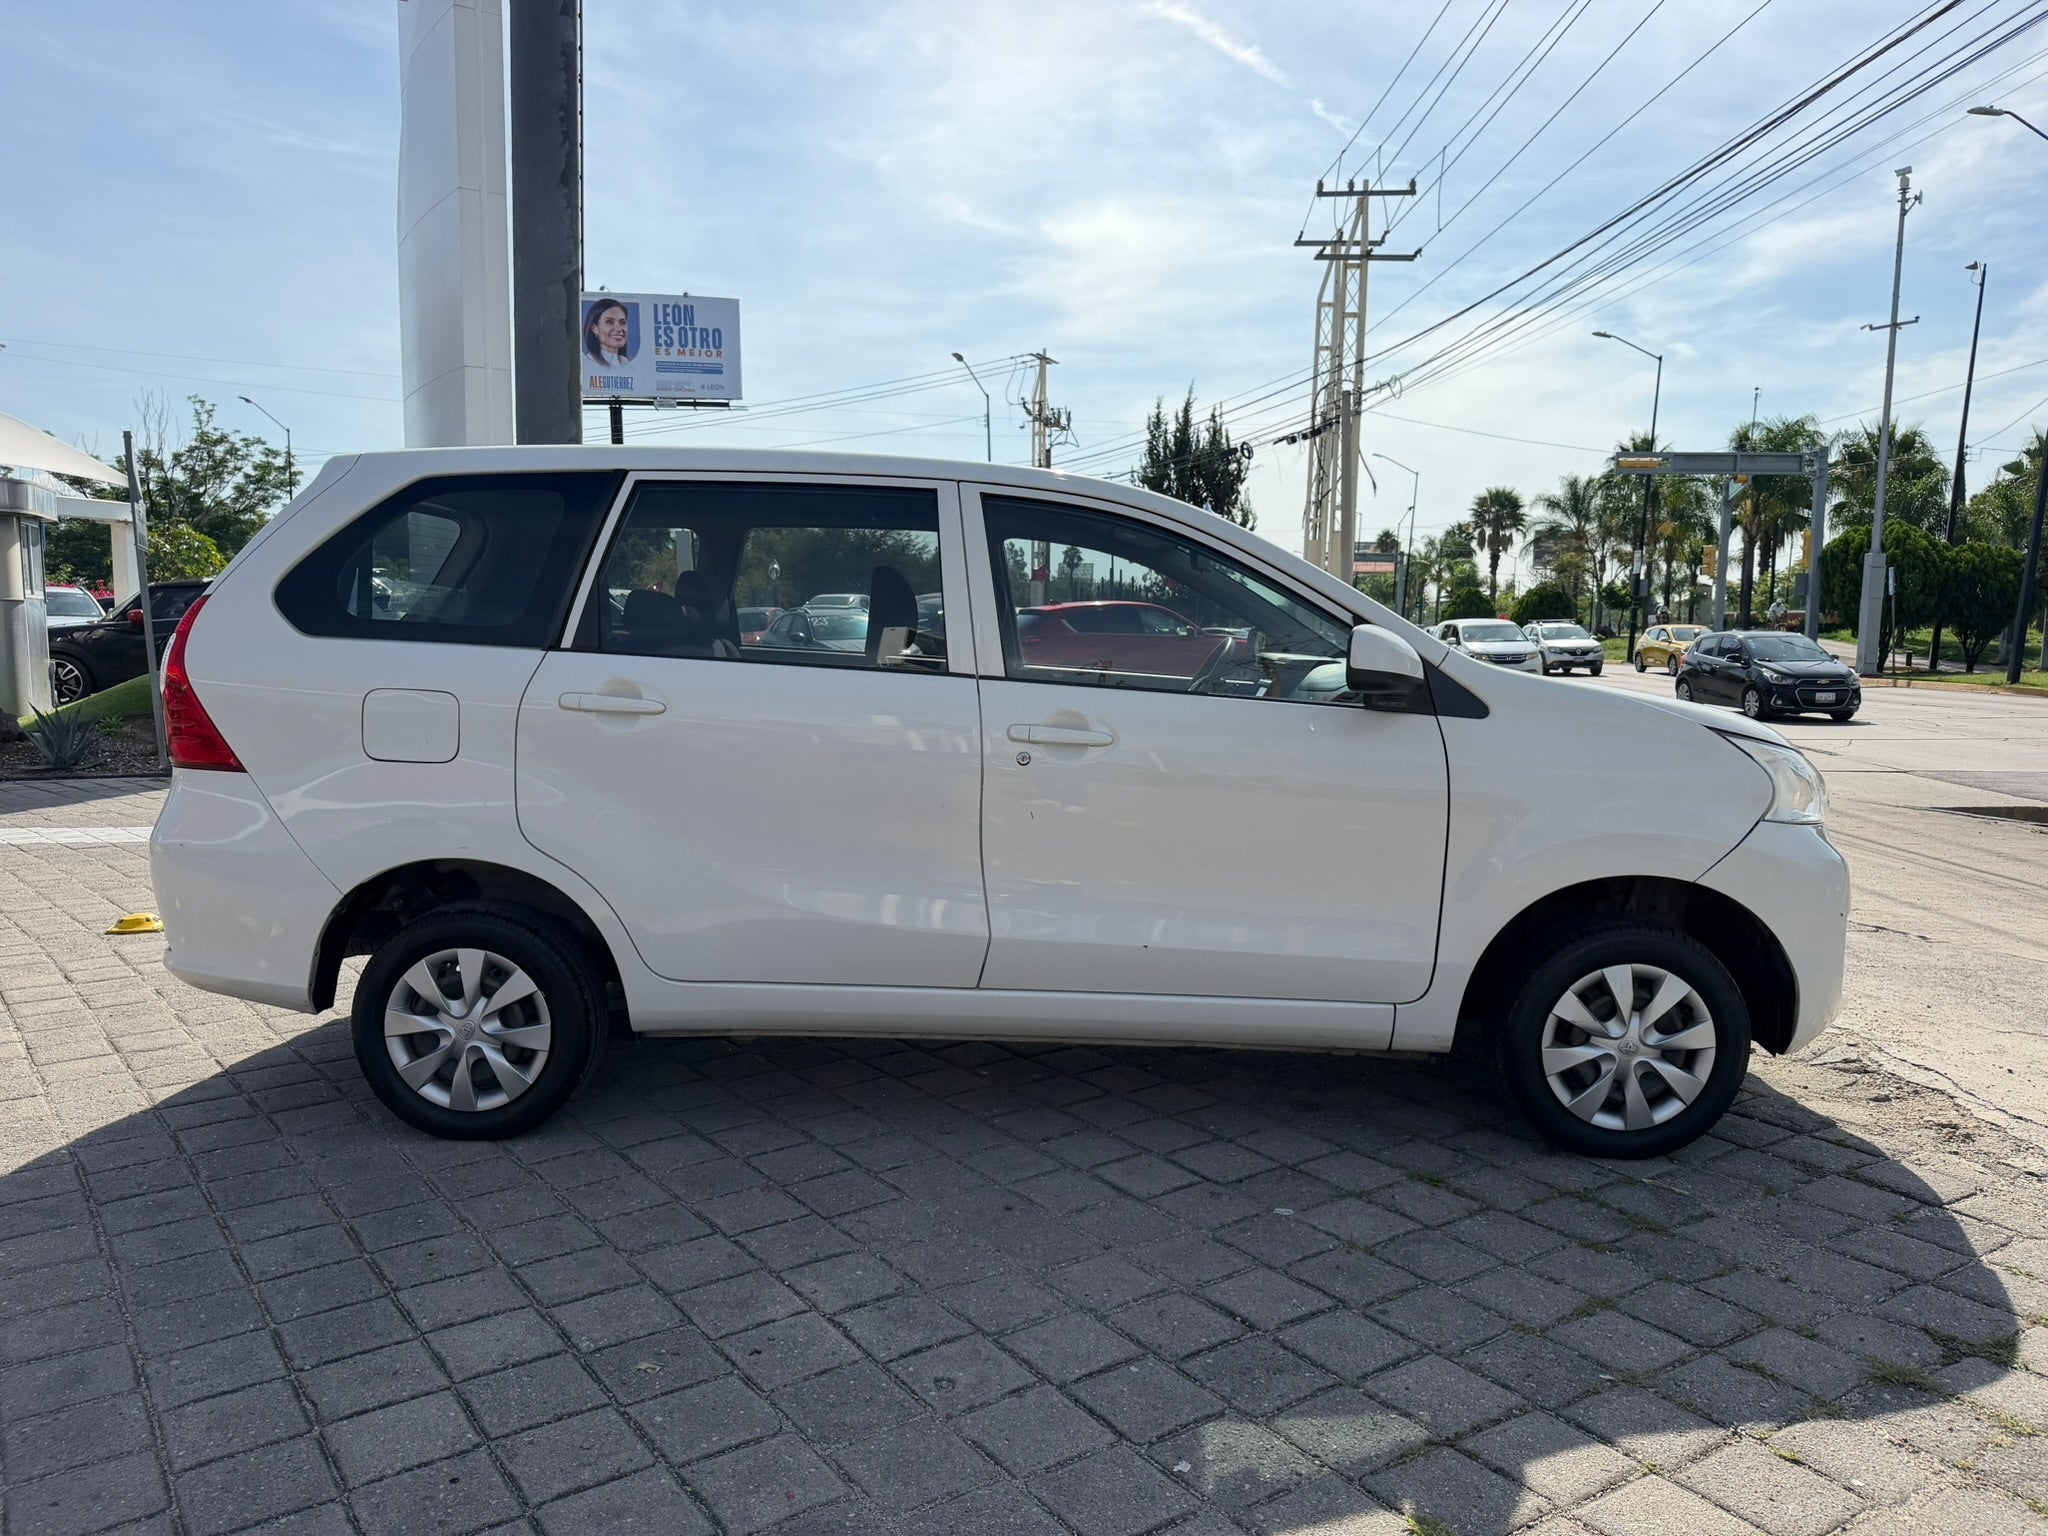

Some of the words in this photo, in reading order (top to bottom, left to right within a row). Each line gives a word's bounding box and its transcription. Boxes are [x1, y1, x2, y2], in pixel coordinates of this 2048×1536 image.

[654, 326, 674, 348] ES
[678, 326, 723, 350] OTRO
[655, 348, 671, 356] ES
[677, 348, 723, 358] MEJOR
